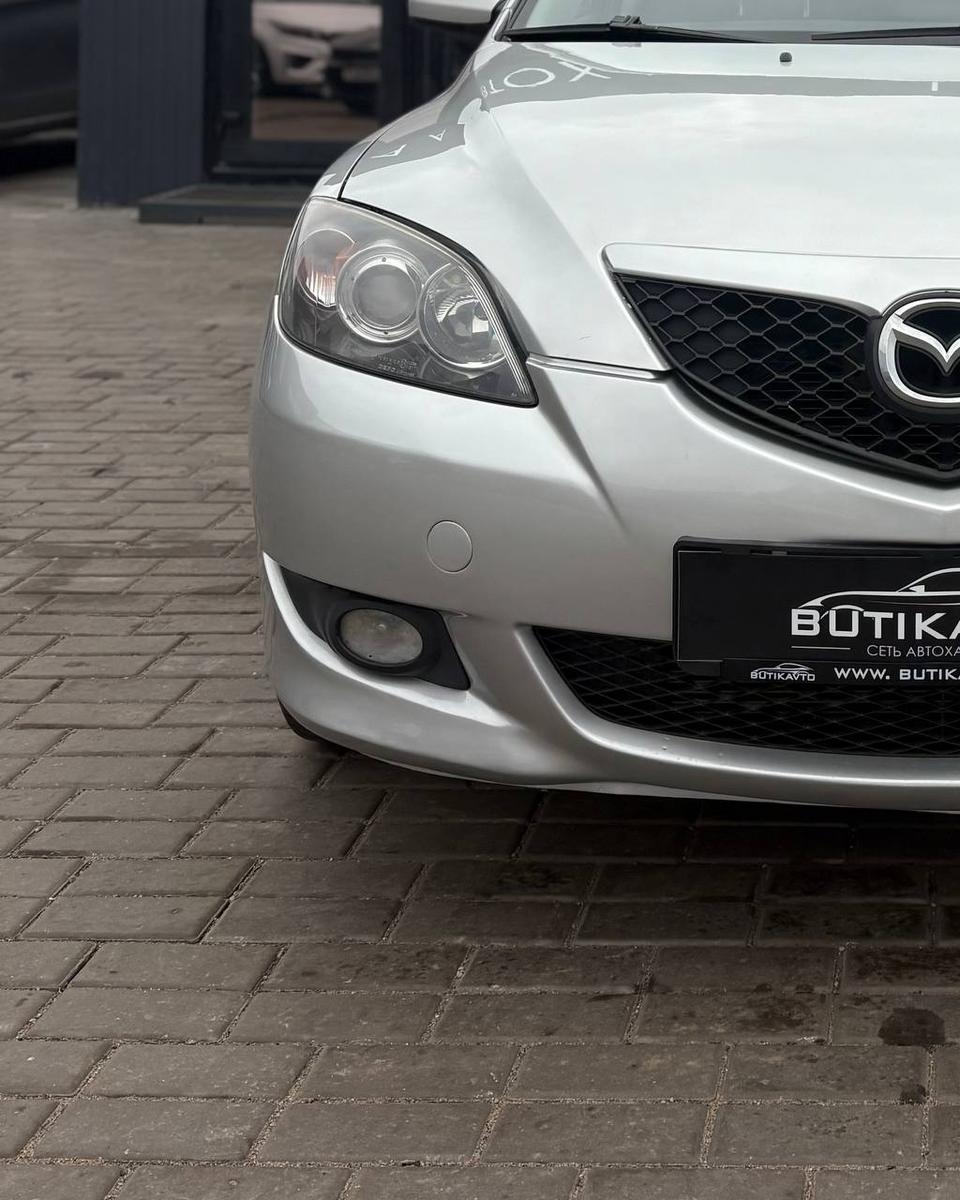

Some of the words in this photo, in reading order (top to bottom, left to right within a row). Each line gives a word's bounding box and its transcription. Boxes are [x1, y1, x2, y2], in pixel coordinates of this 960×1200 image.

[866, 644, 901, 657] СЕТЬ
[750, 670, 816, 682] BUTIKAVTO
[833, 667, 891, 680] WWW.
